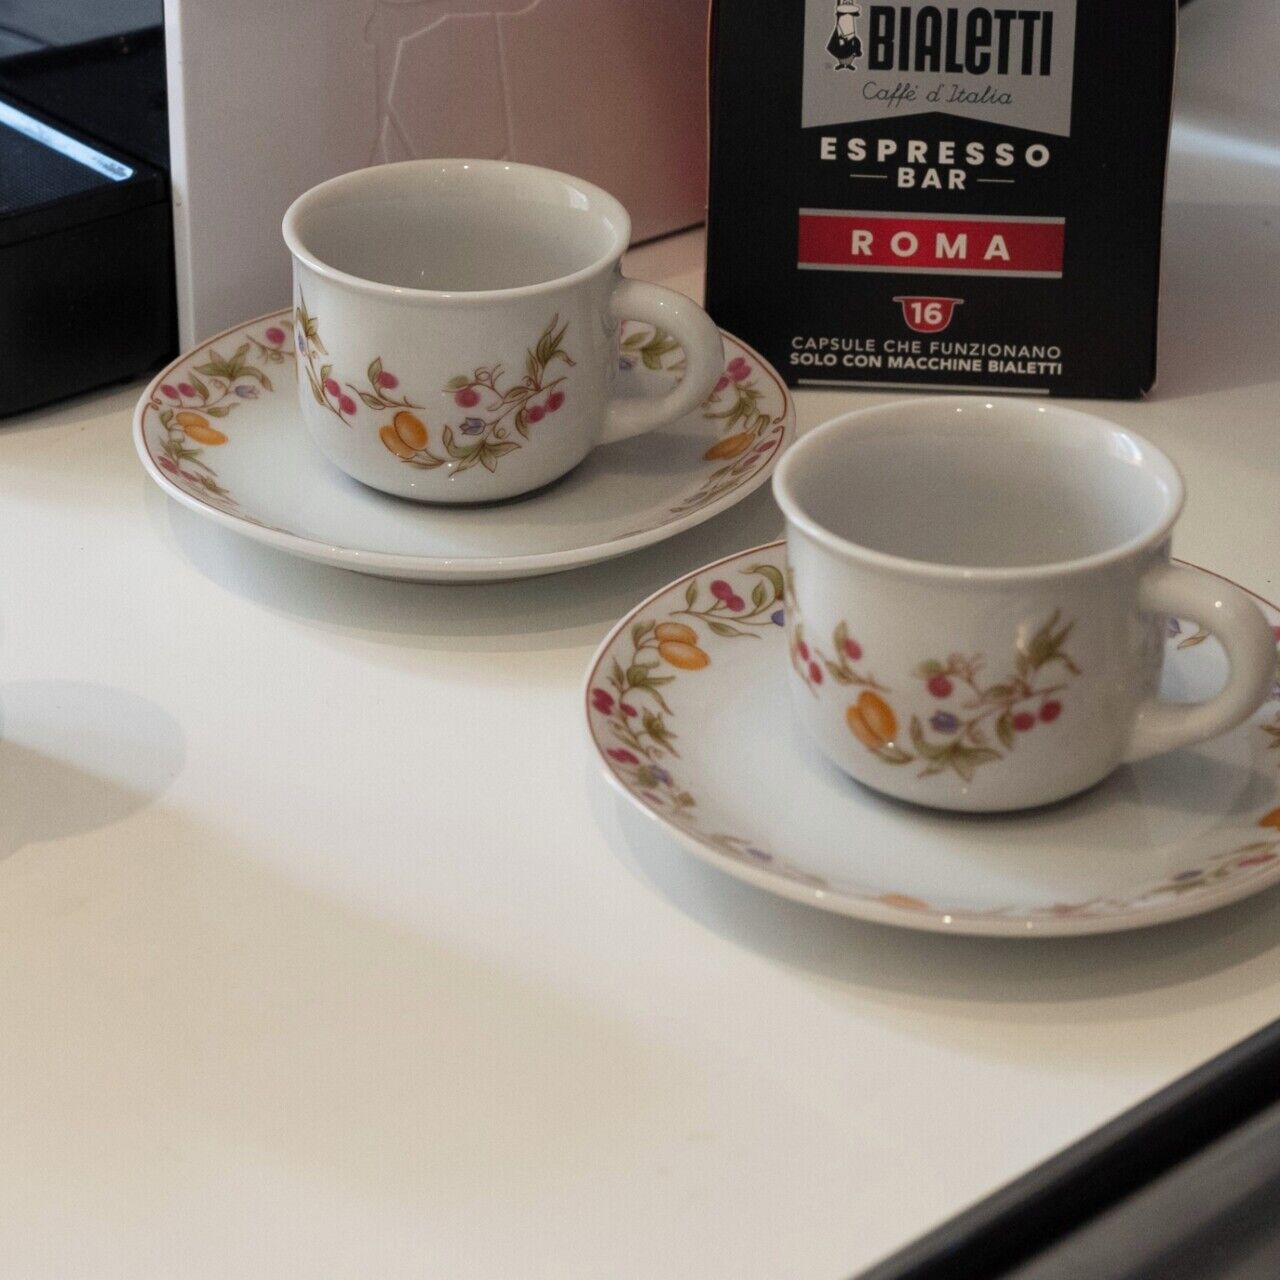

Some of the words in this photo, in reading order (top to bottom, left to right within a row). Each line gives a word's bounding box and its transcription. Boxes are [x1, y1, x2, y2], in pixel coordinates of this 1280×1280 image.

[820, 136, 1051, 168] ESPRESSO
[897, 167, 967, 190] BAR
[851, 229, 1011, 261] ROMA
[910, 302, 943, 325] 16
[791, 336, 876, 352] CAPSULE
[883, 340, 922, 354] CHE
[929, 341, 1062, 360] FUNZIONANO
[789, 352, 838, 367] SOLO
[842, 354, 882, 368] CON
[887, 356, 982, 373] MACCHINE
[987, 360, 1063, 376] BIALETTI
